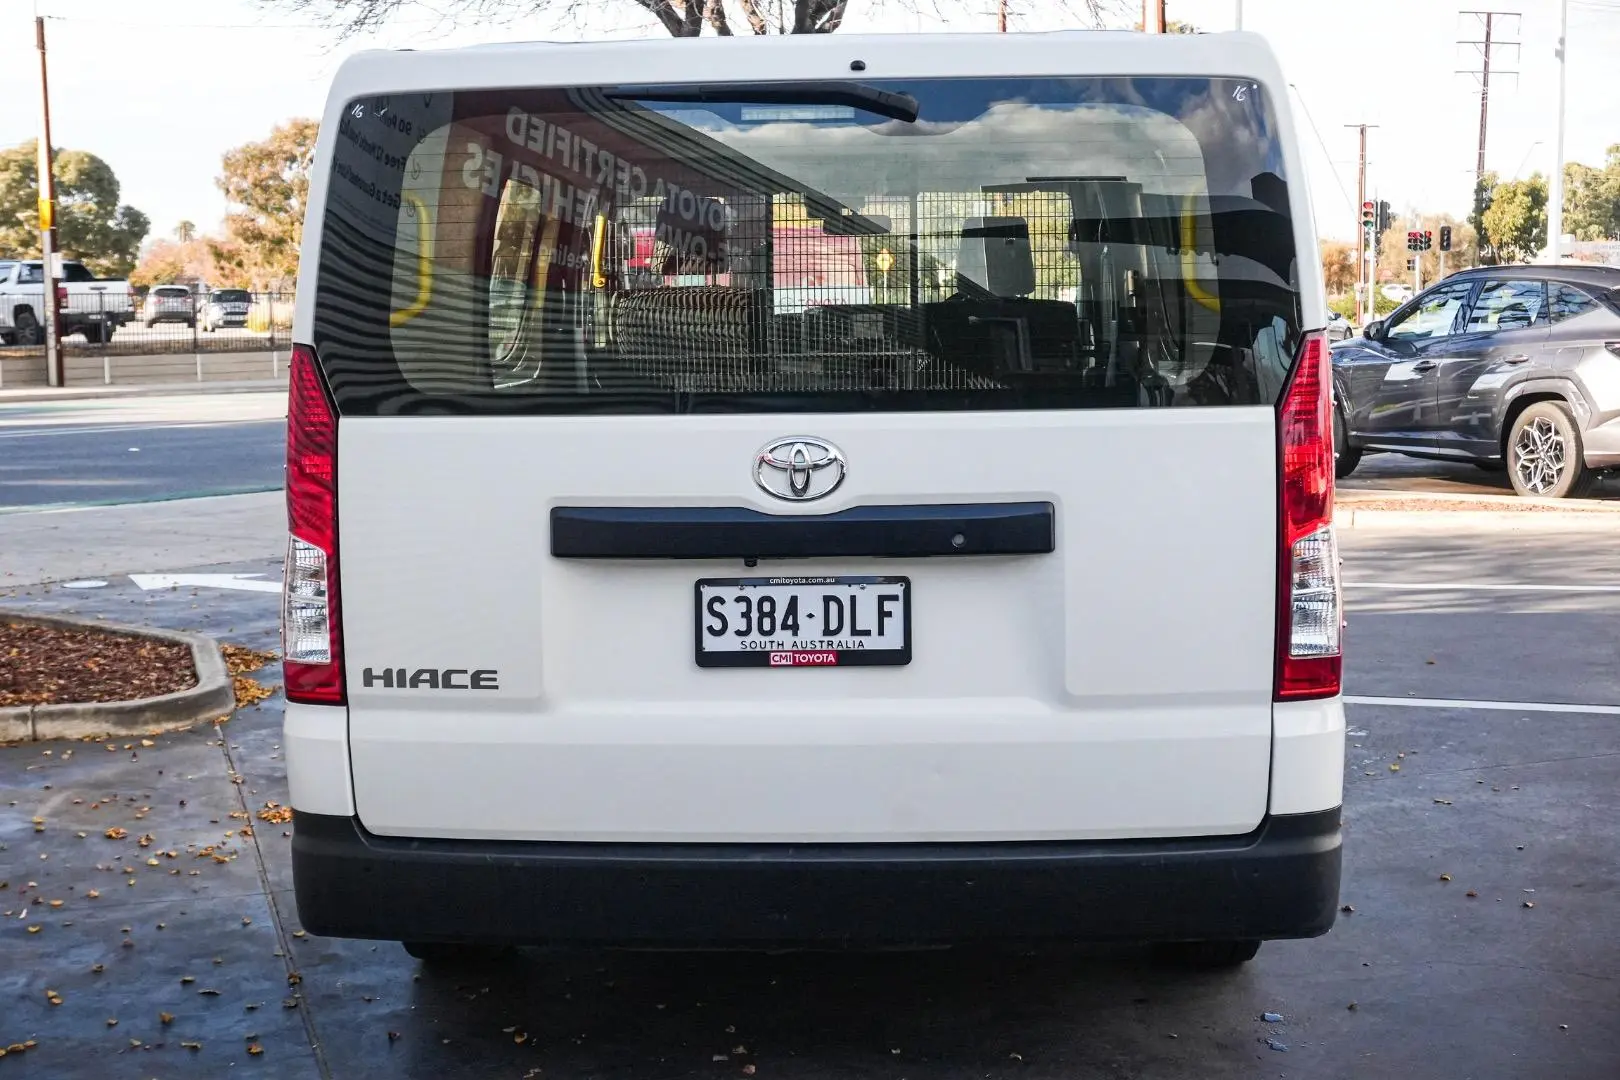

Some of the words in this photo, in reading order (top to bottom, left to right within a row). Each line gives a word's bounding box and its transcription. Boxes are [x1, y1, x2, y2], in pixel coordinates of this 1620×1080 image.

[1232, 85, 1247, 101] 16
[351, 103, 365, 118] 16
[769, 577, 835, 585] cmitoyota.com.au
[740, 640, 785, 650] SOUTH
[791, 640, 865, 650] AUSTRALIA
[772, 654, 792, 664] CMI
[794, 653, 836, 664] TOYOTA
[363, 668, 499, 690] HIACE
